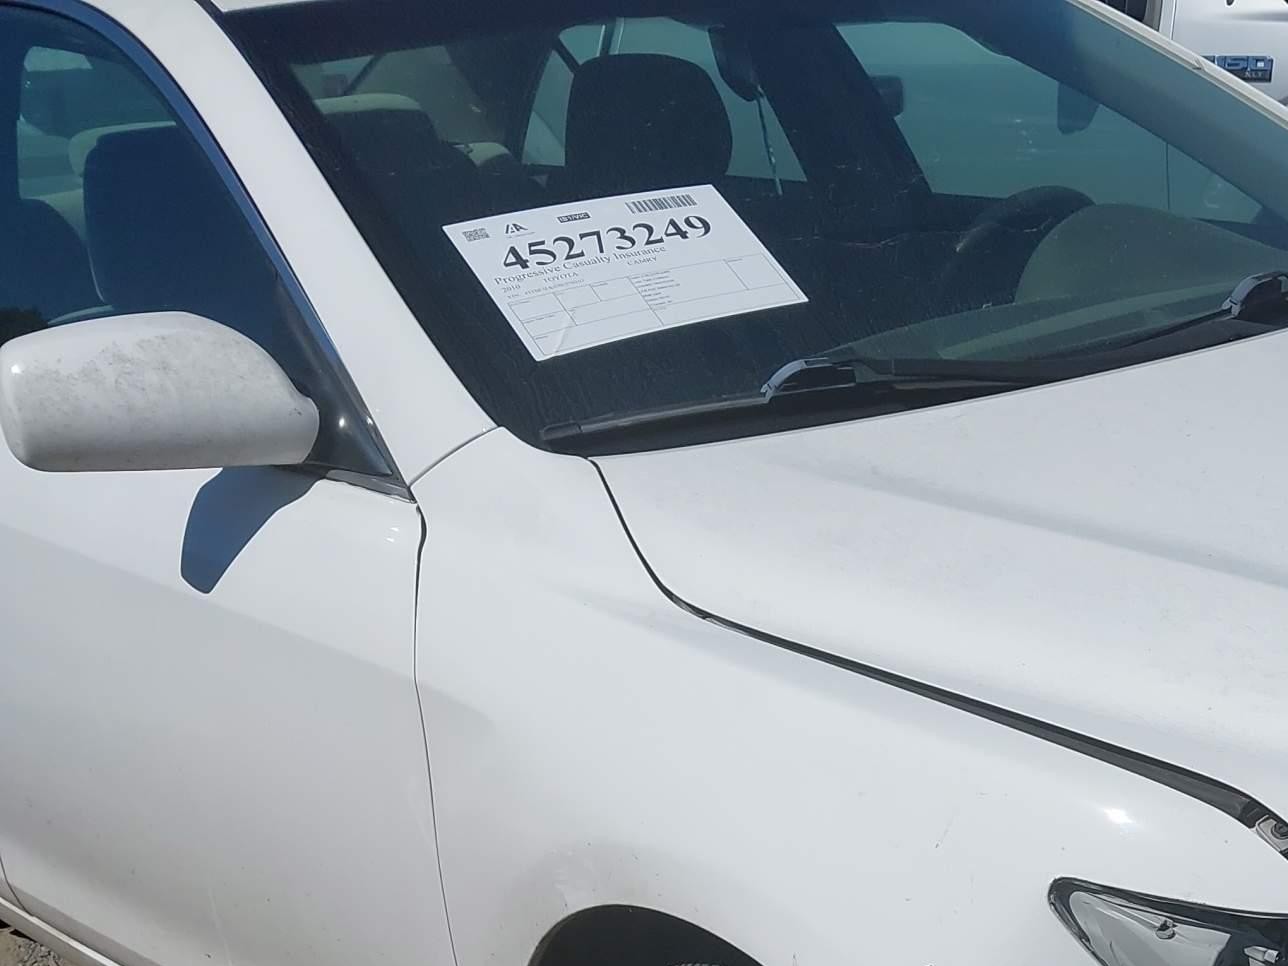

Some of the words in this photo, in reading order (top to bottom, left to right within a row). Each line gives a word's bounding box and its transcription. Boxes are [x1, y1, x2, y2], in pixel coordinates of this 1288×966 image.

[503, 214, 712, 270] 45273249
[494, 267, 561, 287] Progressive
[563, 254, 612, 271] Casualty
[615, 245, 666, 263] Insurance
[543, 272, 579, 284] TOYOTA
[627, 256, 657, 267] CAMRY
